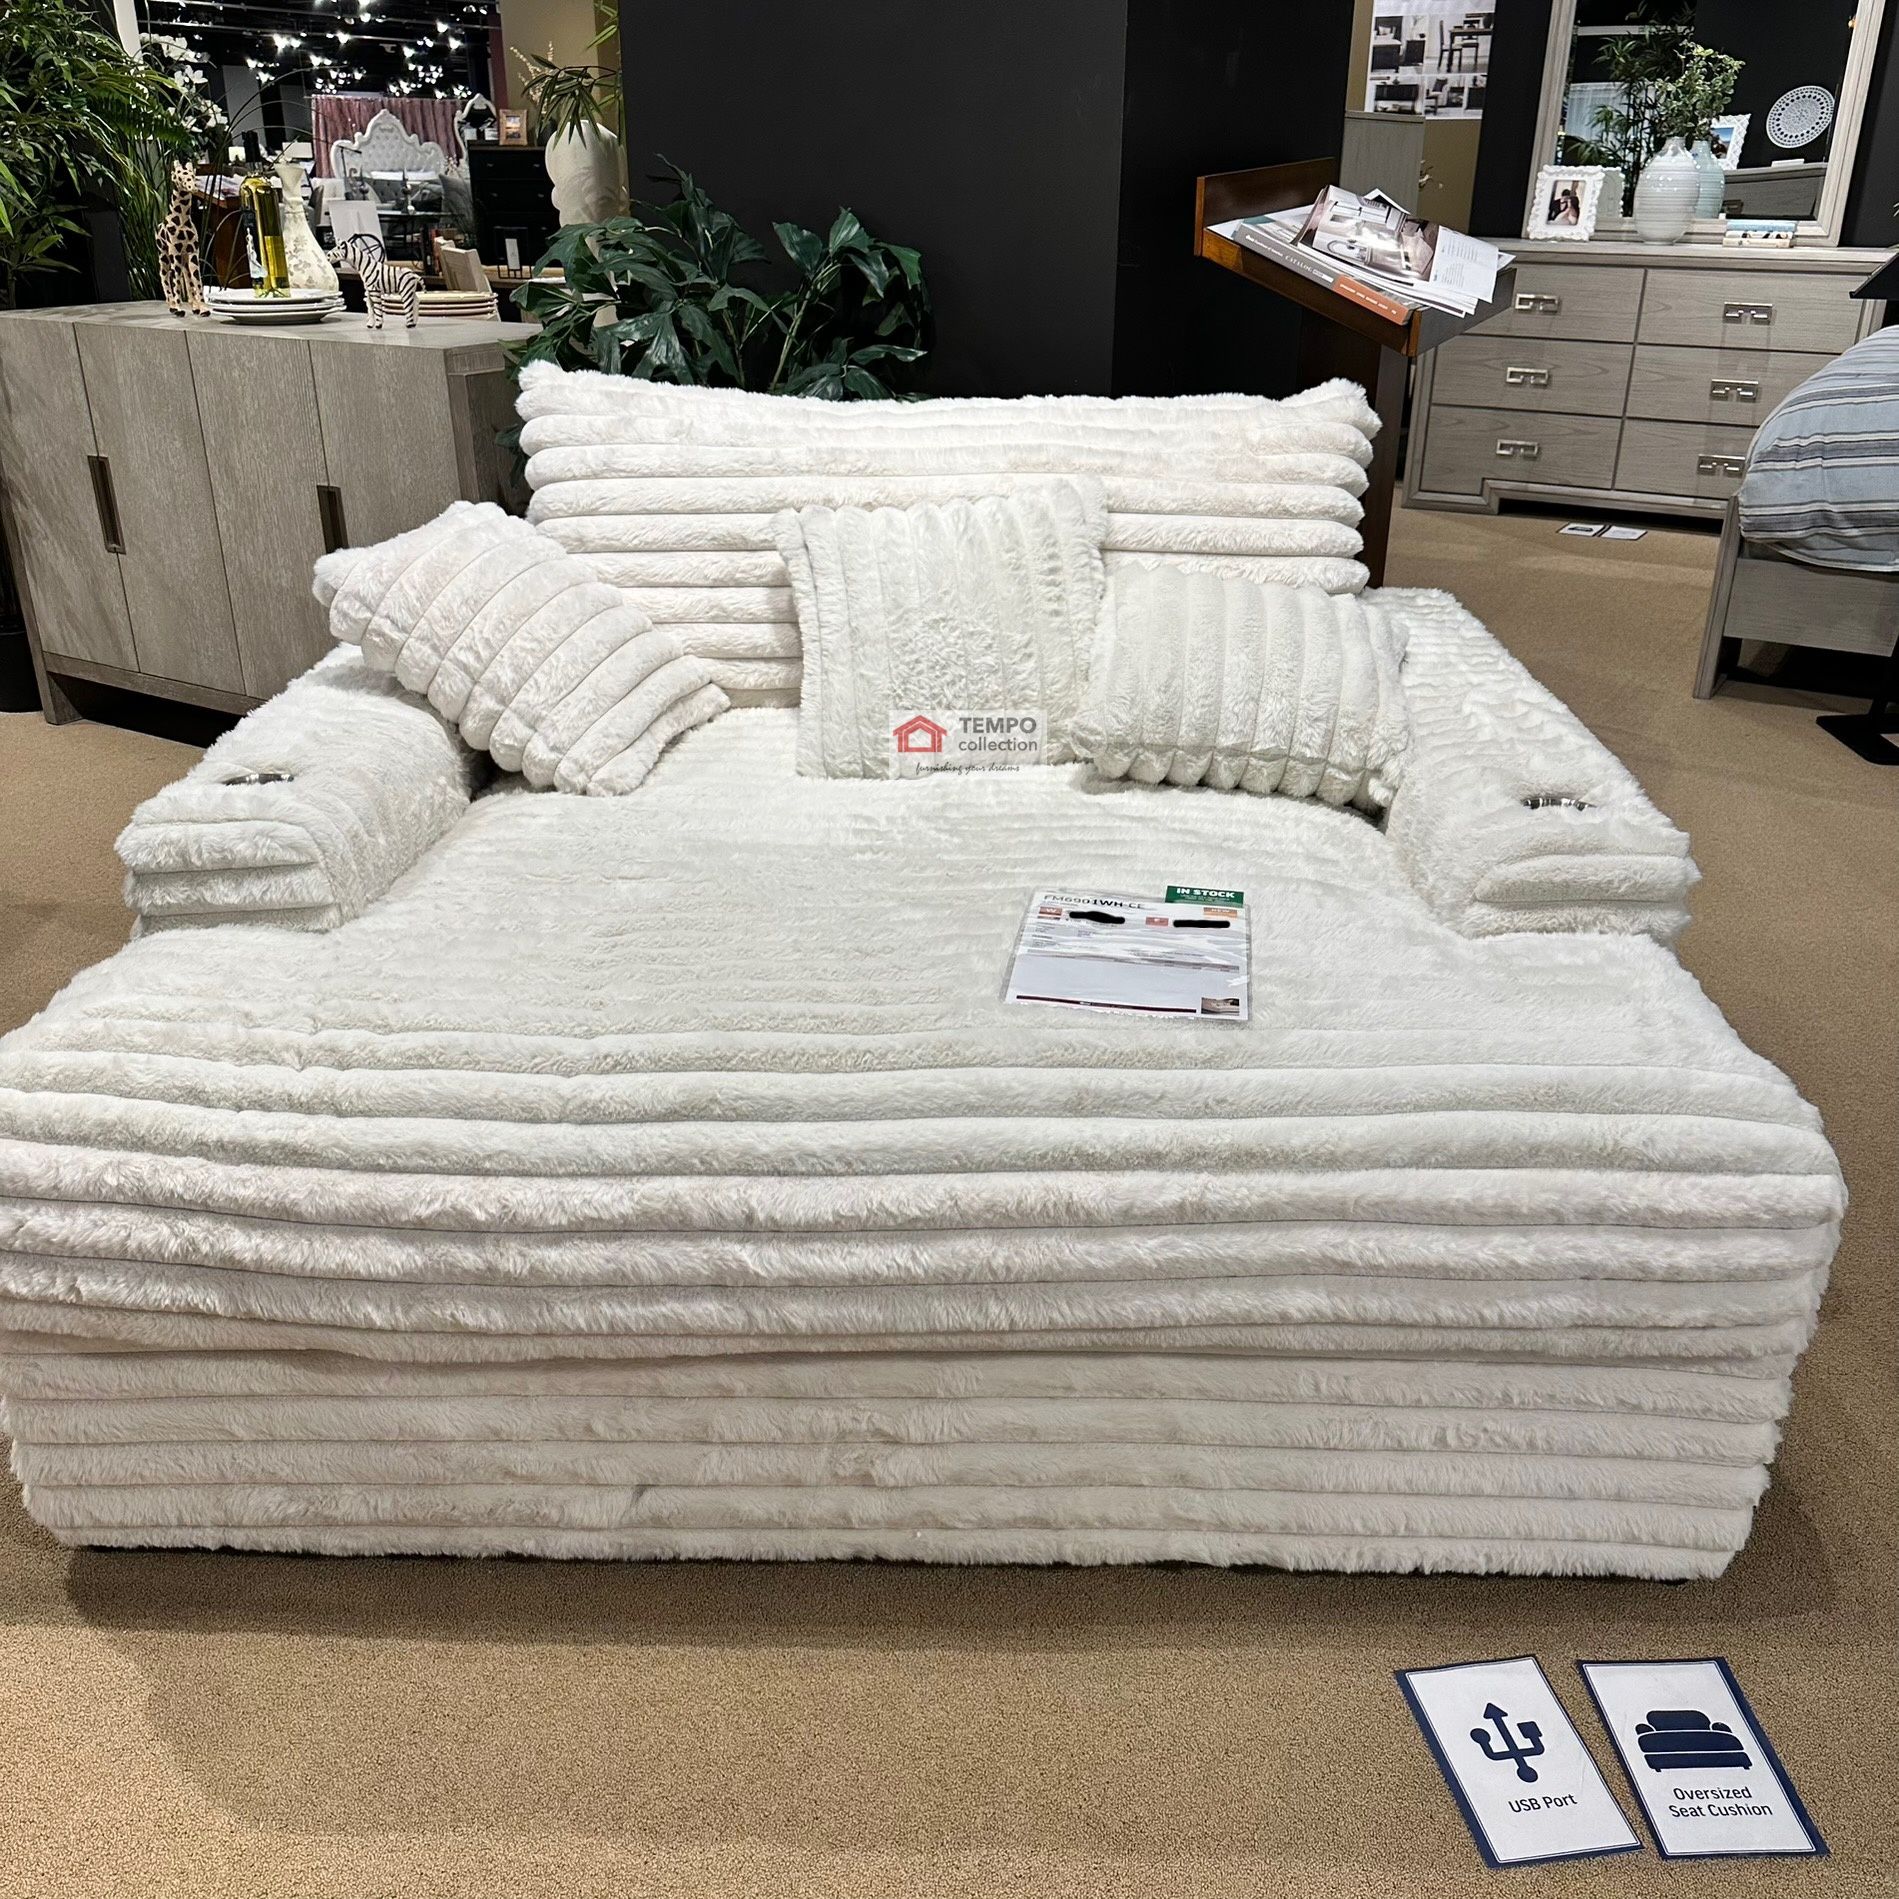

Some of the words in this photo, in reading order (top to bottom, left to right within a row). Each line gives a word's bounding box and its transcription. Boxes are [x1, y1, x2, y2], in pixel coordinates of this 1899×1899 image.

[1176, 887, 1191, 895] IN
[1193, 889, 1235, 898] STOCK
[1673, 1786, 1752, 1800] Oversized
[1508, 1797, 1541, 1813] USB
[1542, 1794, 1578, 1809] Port
[1668, 1804, 1706, 1818] Seat
[1707, 1803, 1773, 1817] Cushion
